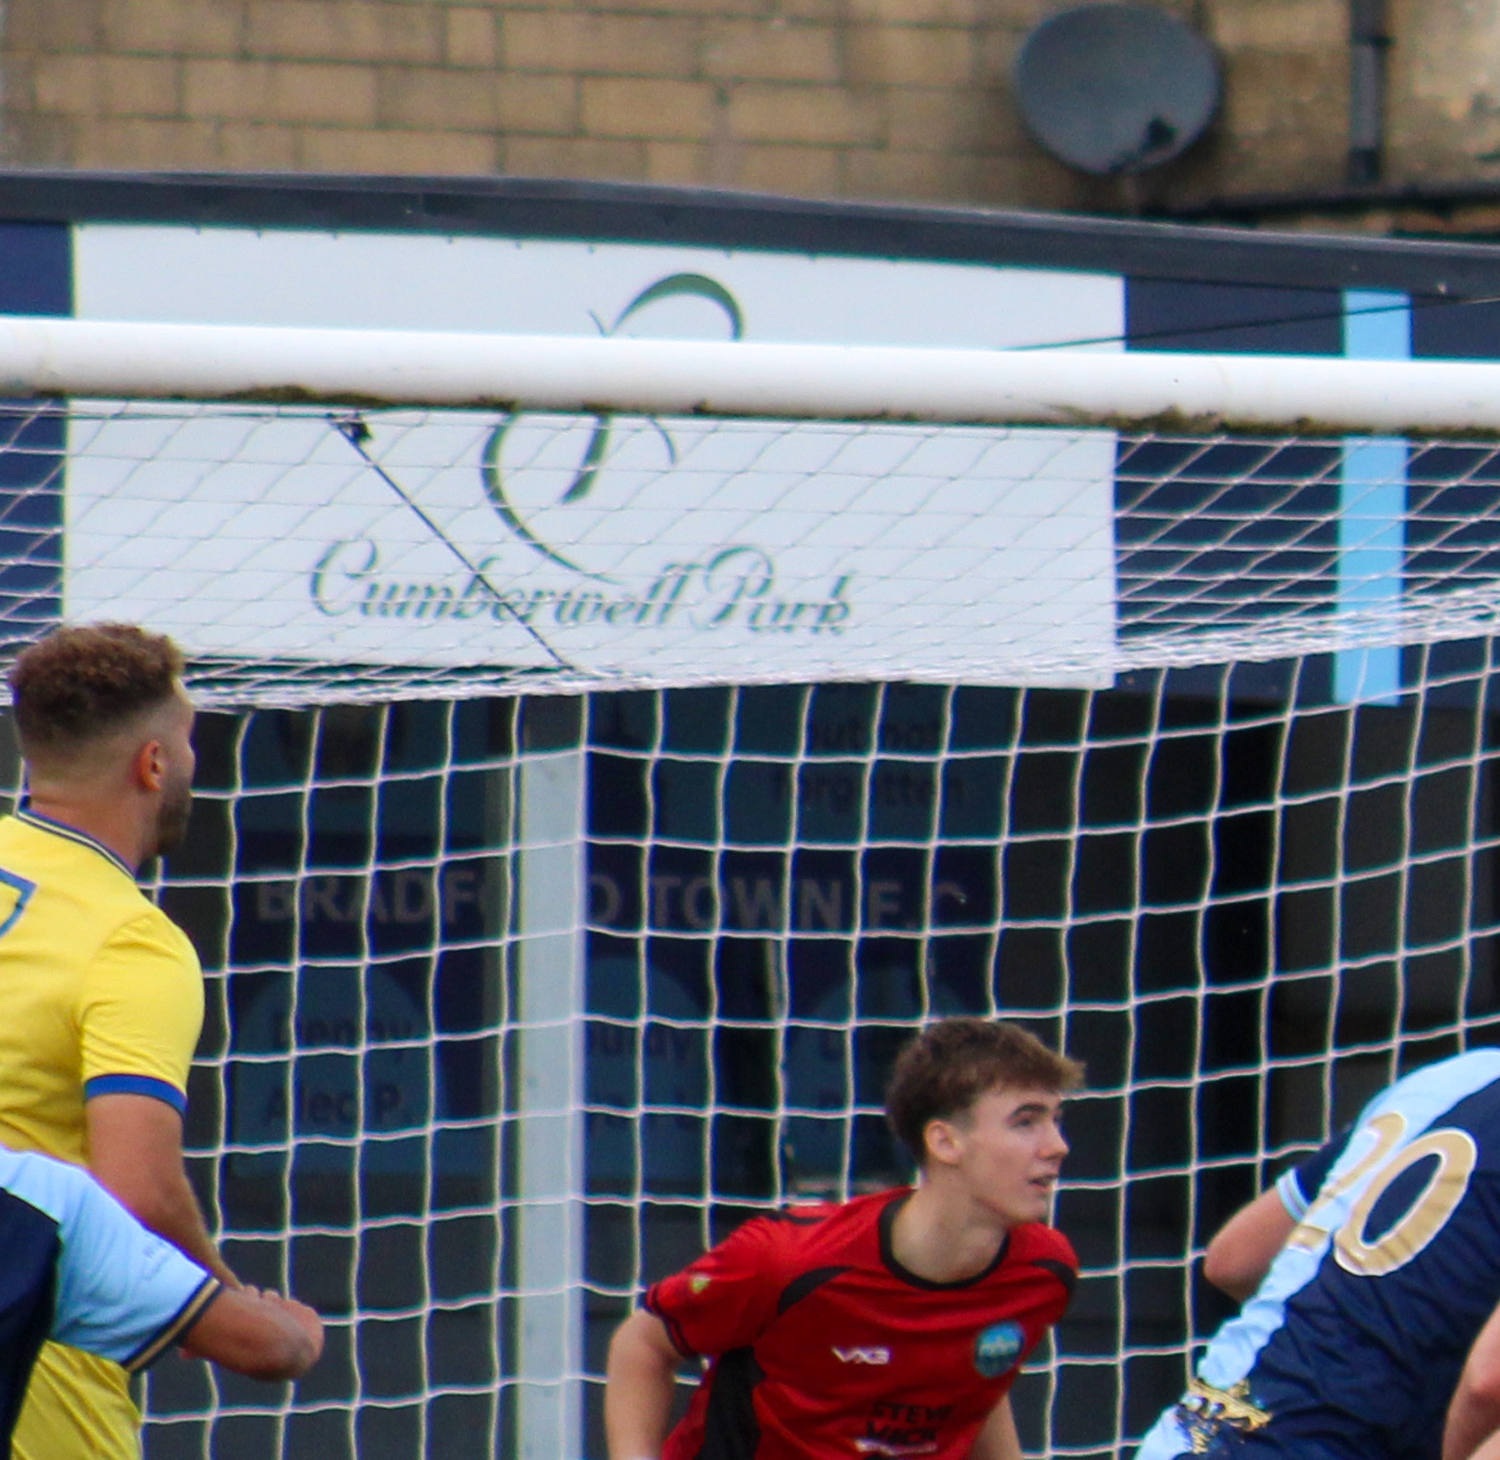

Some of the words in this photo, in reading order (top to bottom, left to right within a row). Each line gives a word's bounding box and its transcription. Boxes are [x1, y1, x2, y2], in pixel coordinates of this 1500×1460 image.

[311, 538, 698, 624] Cumberwell
[692, 544, 857, 634] Park
[256, 872, 620, 927] BRADFD
[648, 878, 841, 931] TOWN
[1287, 1110, 1478, 1278] 20
